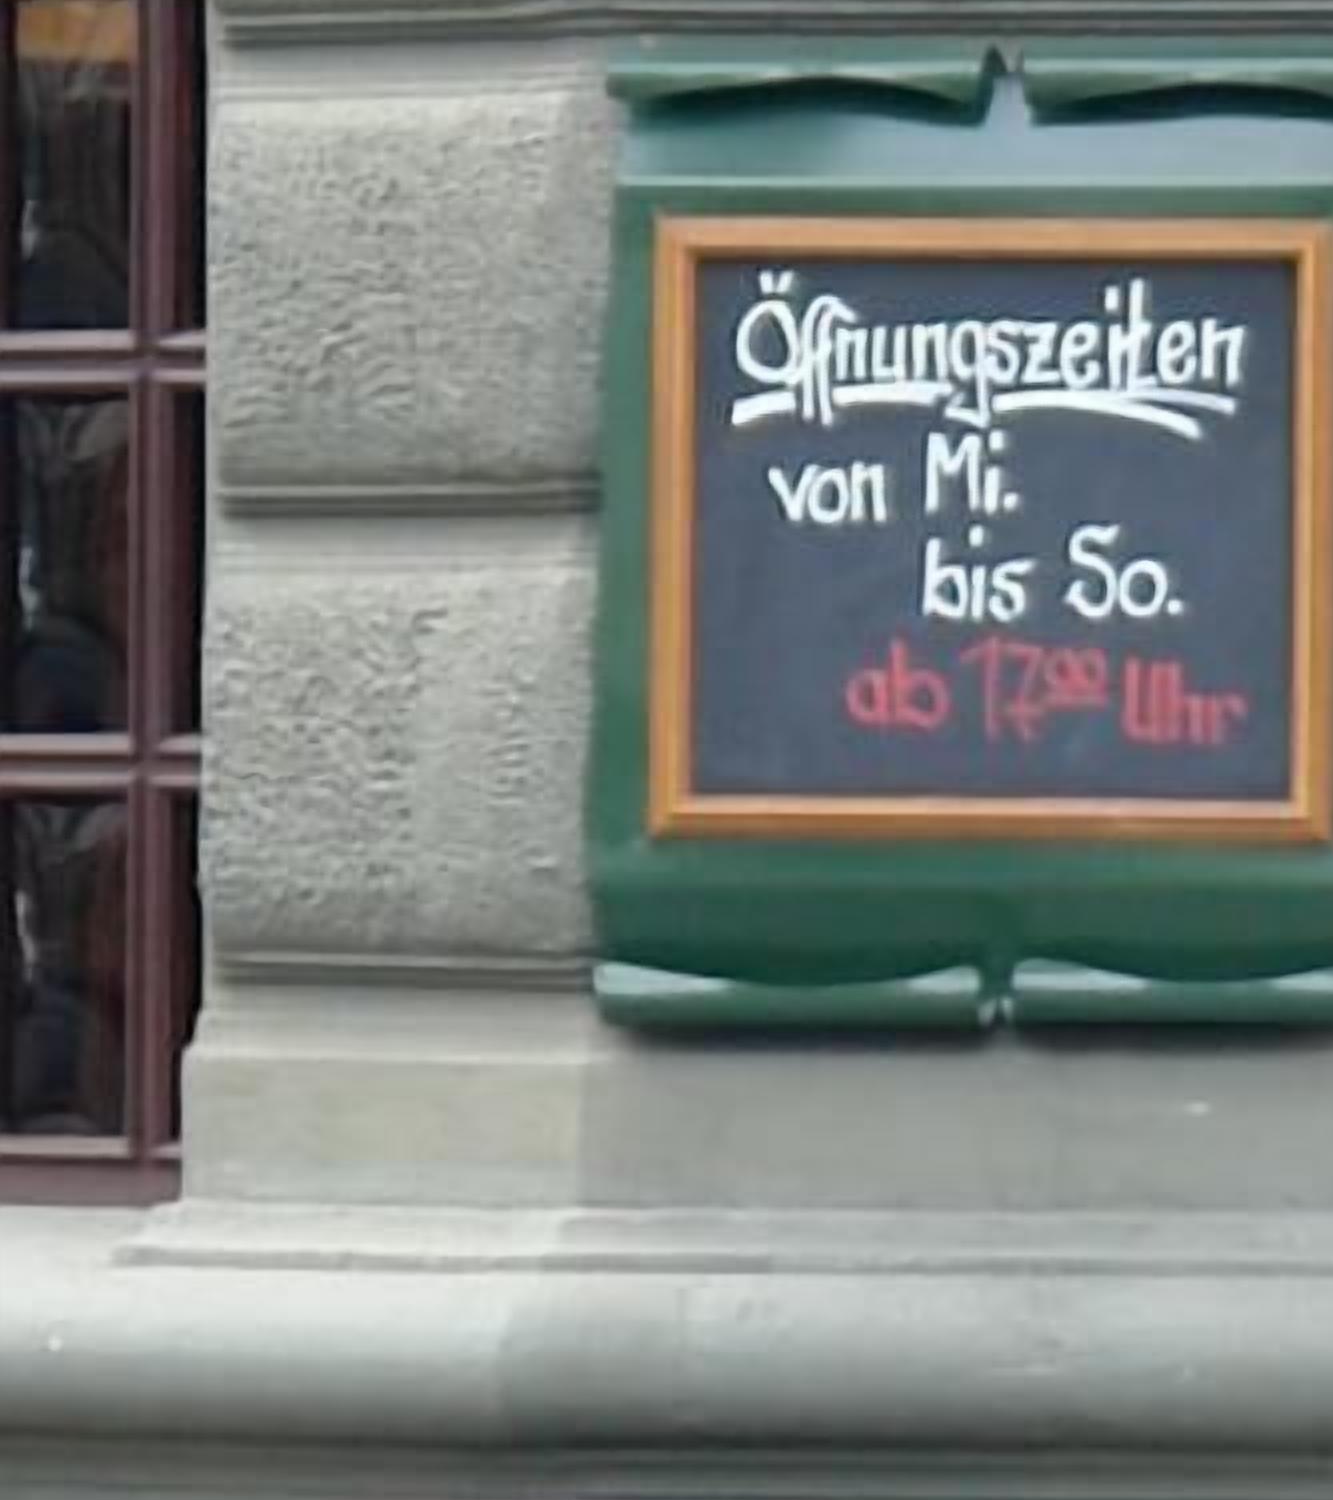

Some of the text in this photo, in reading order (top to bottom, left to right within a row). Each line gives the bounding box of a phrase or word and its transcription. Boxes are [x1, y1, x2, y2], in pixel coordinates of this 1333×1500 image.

[733, 270, 1246, 428] Öffnungszeiten
[769, 429, 1020, 524] von Mi.
[921, 524, 1184, 622] bis So.
[845, 638, 950, 732] ab
[1121, 656, 1250, 746] Uhr
